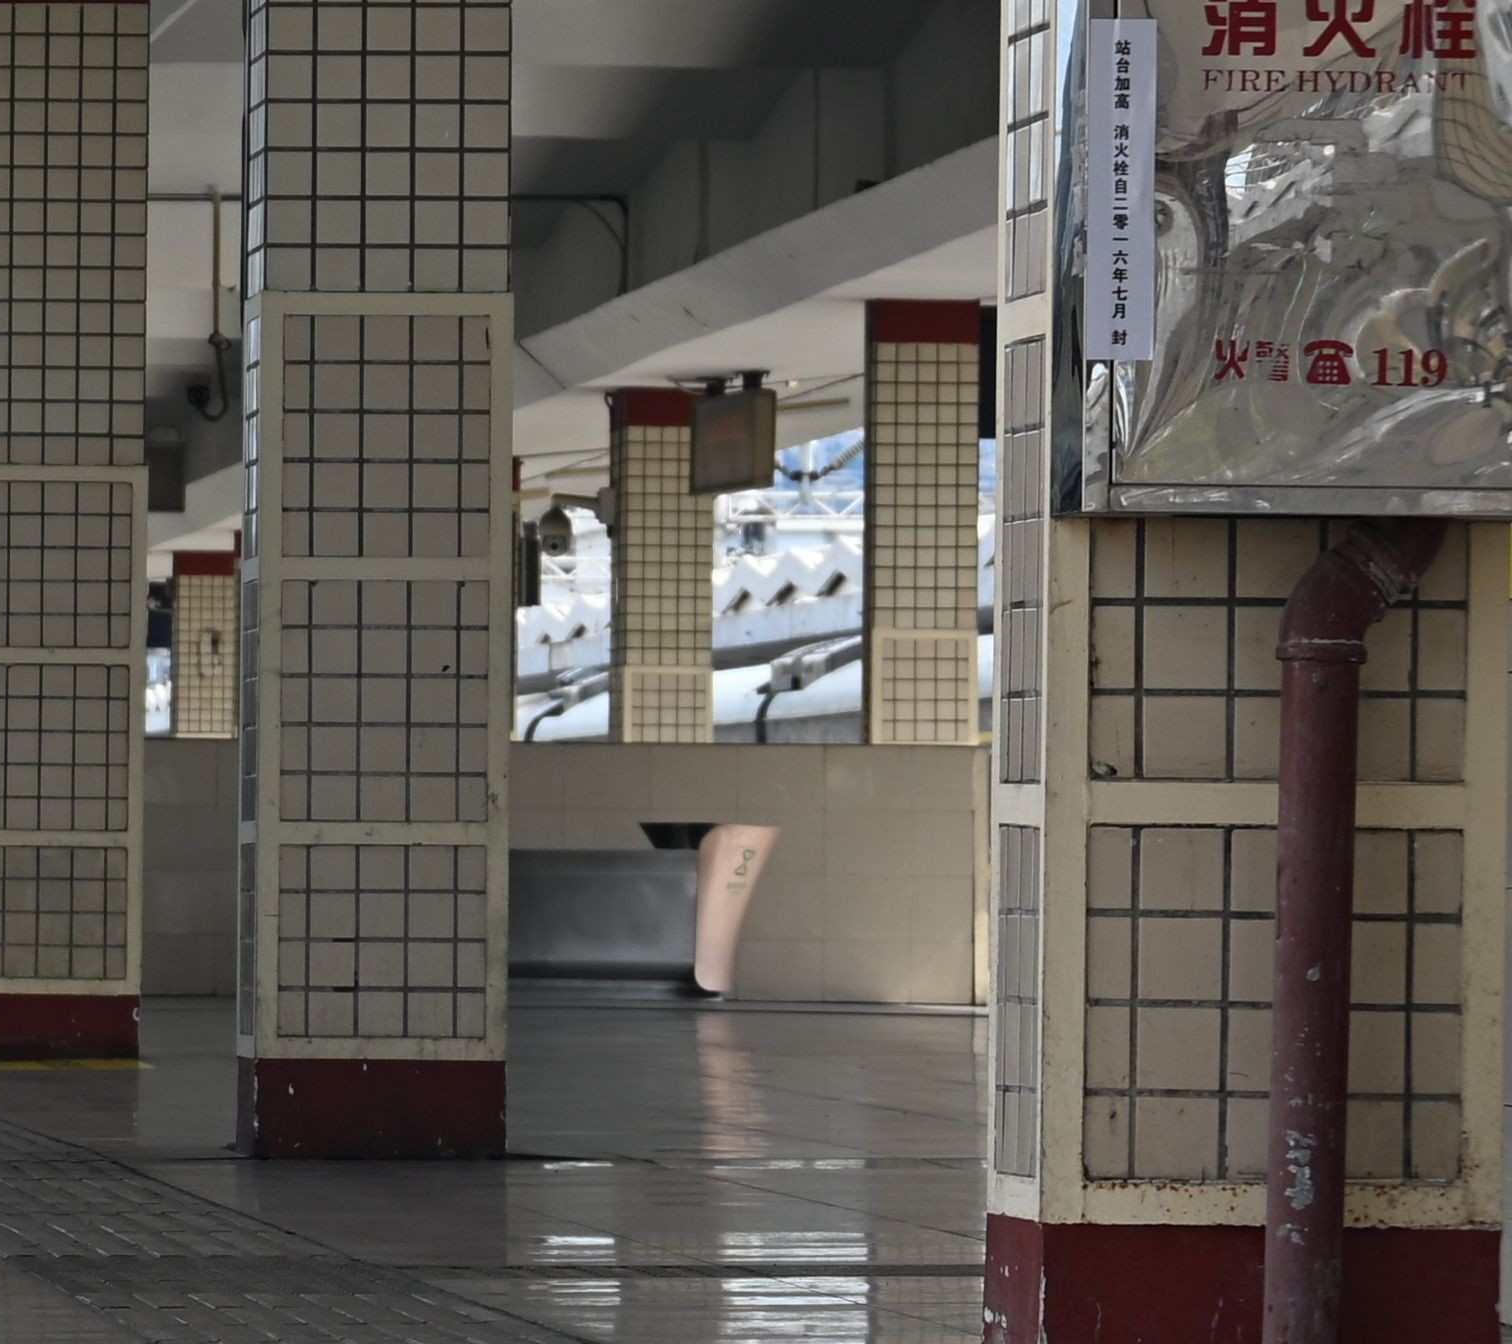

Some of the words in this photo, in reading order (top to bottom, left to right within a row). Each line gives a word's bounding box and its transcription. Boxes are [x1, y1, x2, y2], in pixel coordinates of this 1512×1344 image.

[1114, 40, 1131, 110] 站台加高
[1203, 68, 1288, 94] FIRE
[1295, 68, 1473, 94] HYDRANT
[1112, 124, 1130, 320] 消火栓自二零一六年七月
[1111, 330, 1128, 346] 封
[1214, 338, 1291, 383] 火警
[1371, 347, 1448, 387] 119
